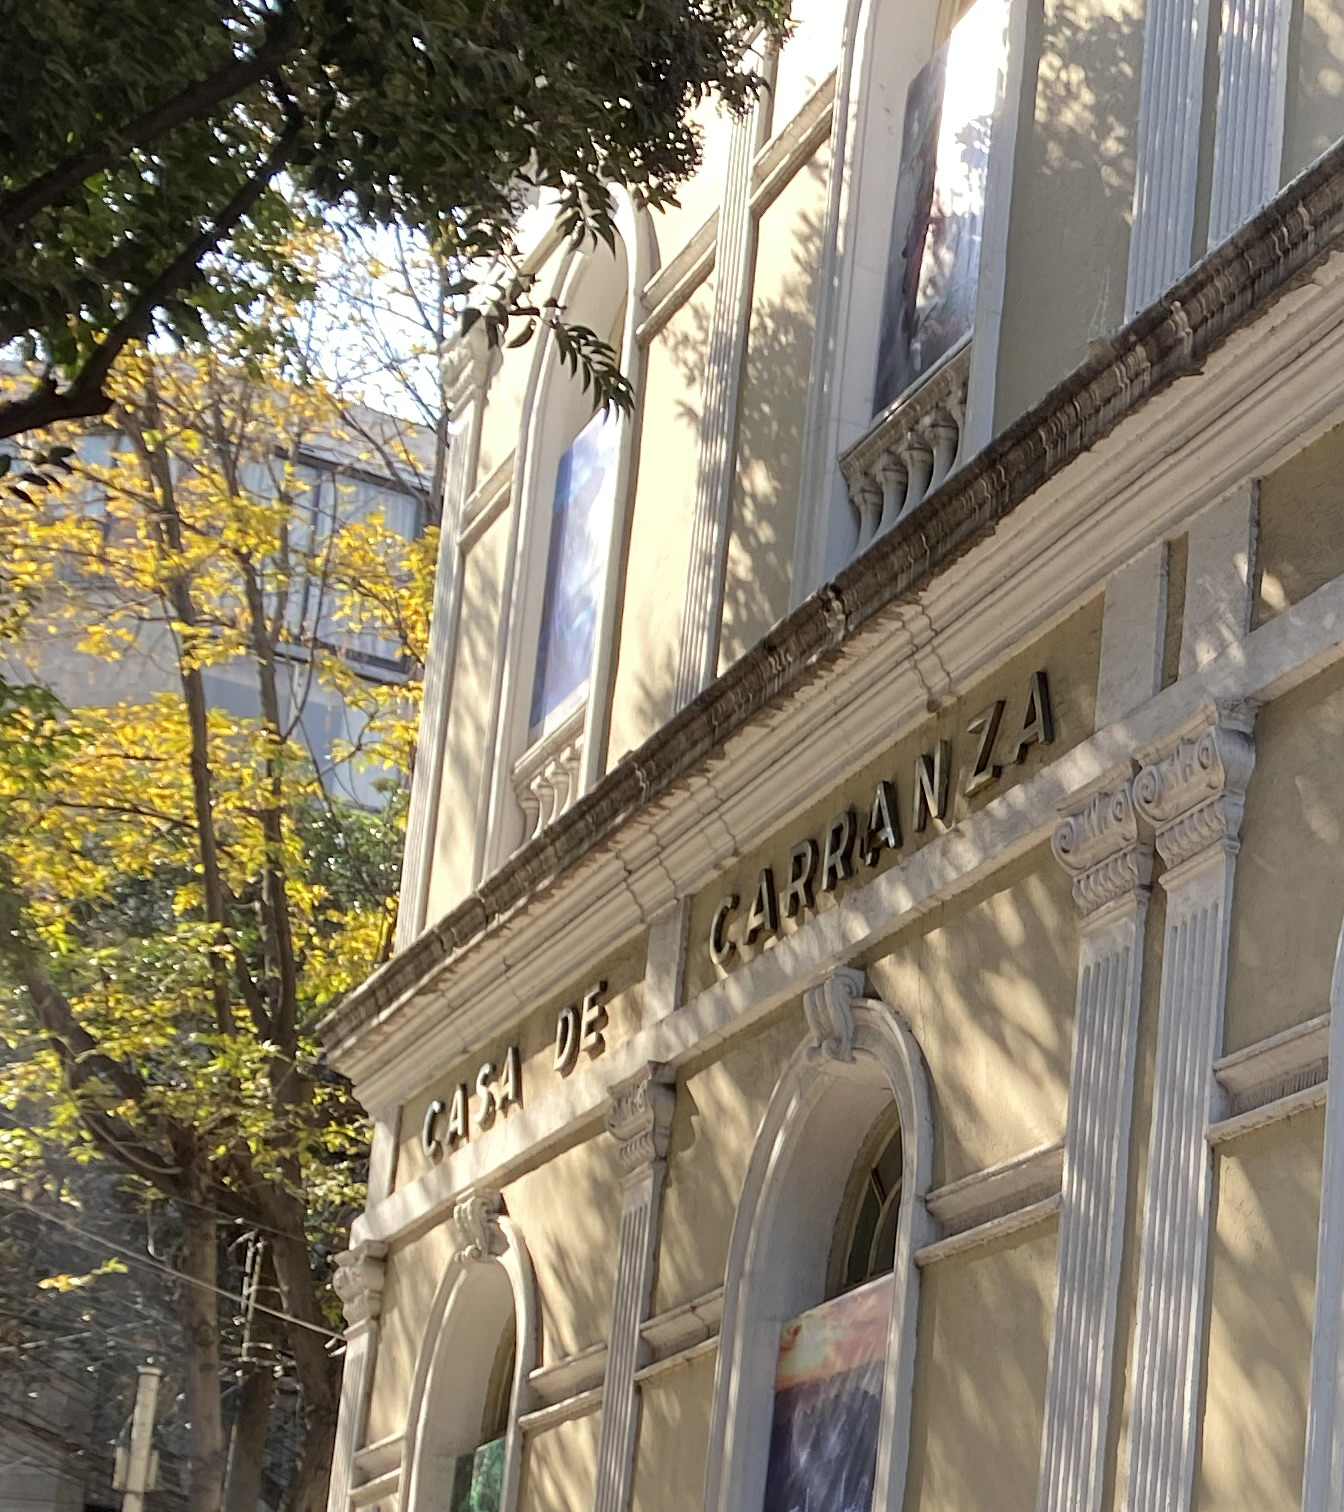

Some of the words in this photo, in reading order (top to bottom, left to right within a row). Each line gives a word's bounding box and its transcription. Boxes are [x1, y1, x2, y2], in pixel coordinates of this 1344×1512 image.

[422, 1046, 522, 1162] CASA
[553, 980, 608, 1071] DE
[709, 671, 1056, 965] CARRANZA
